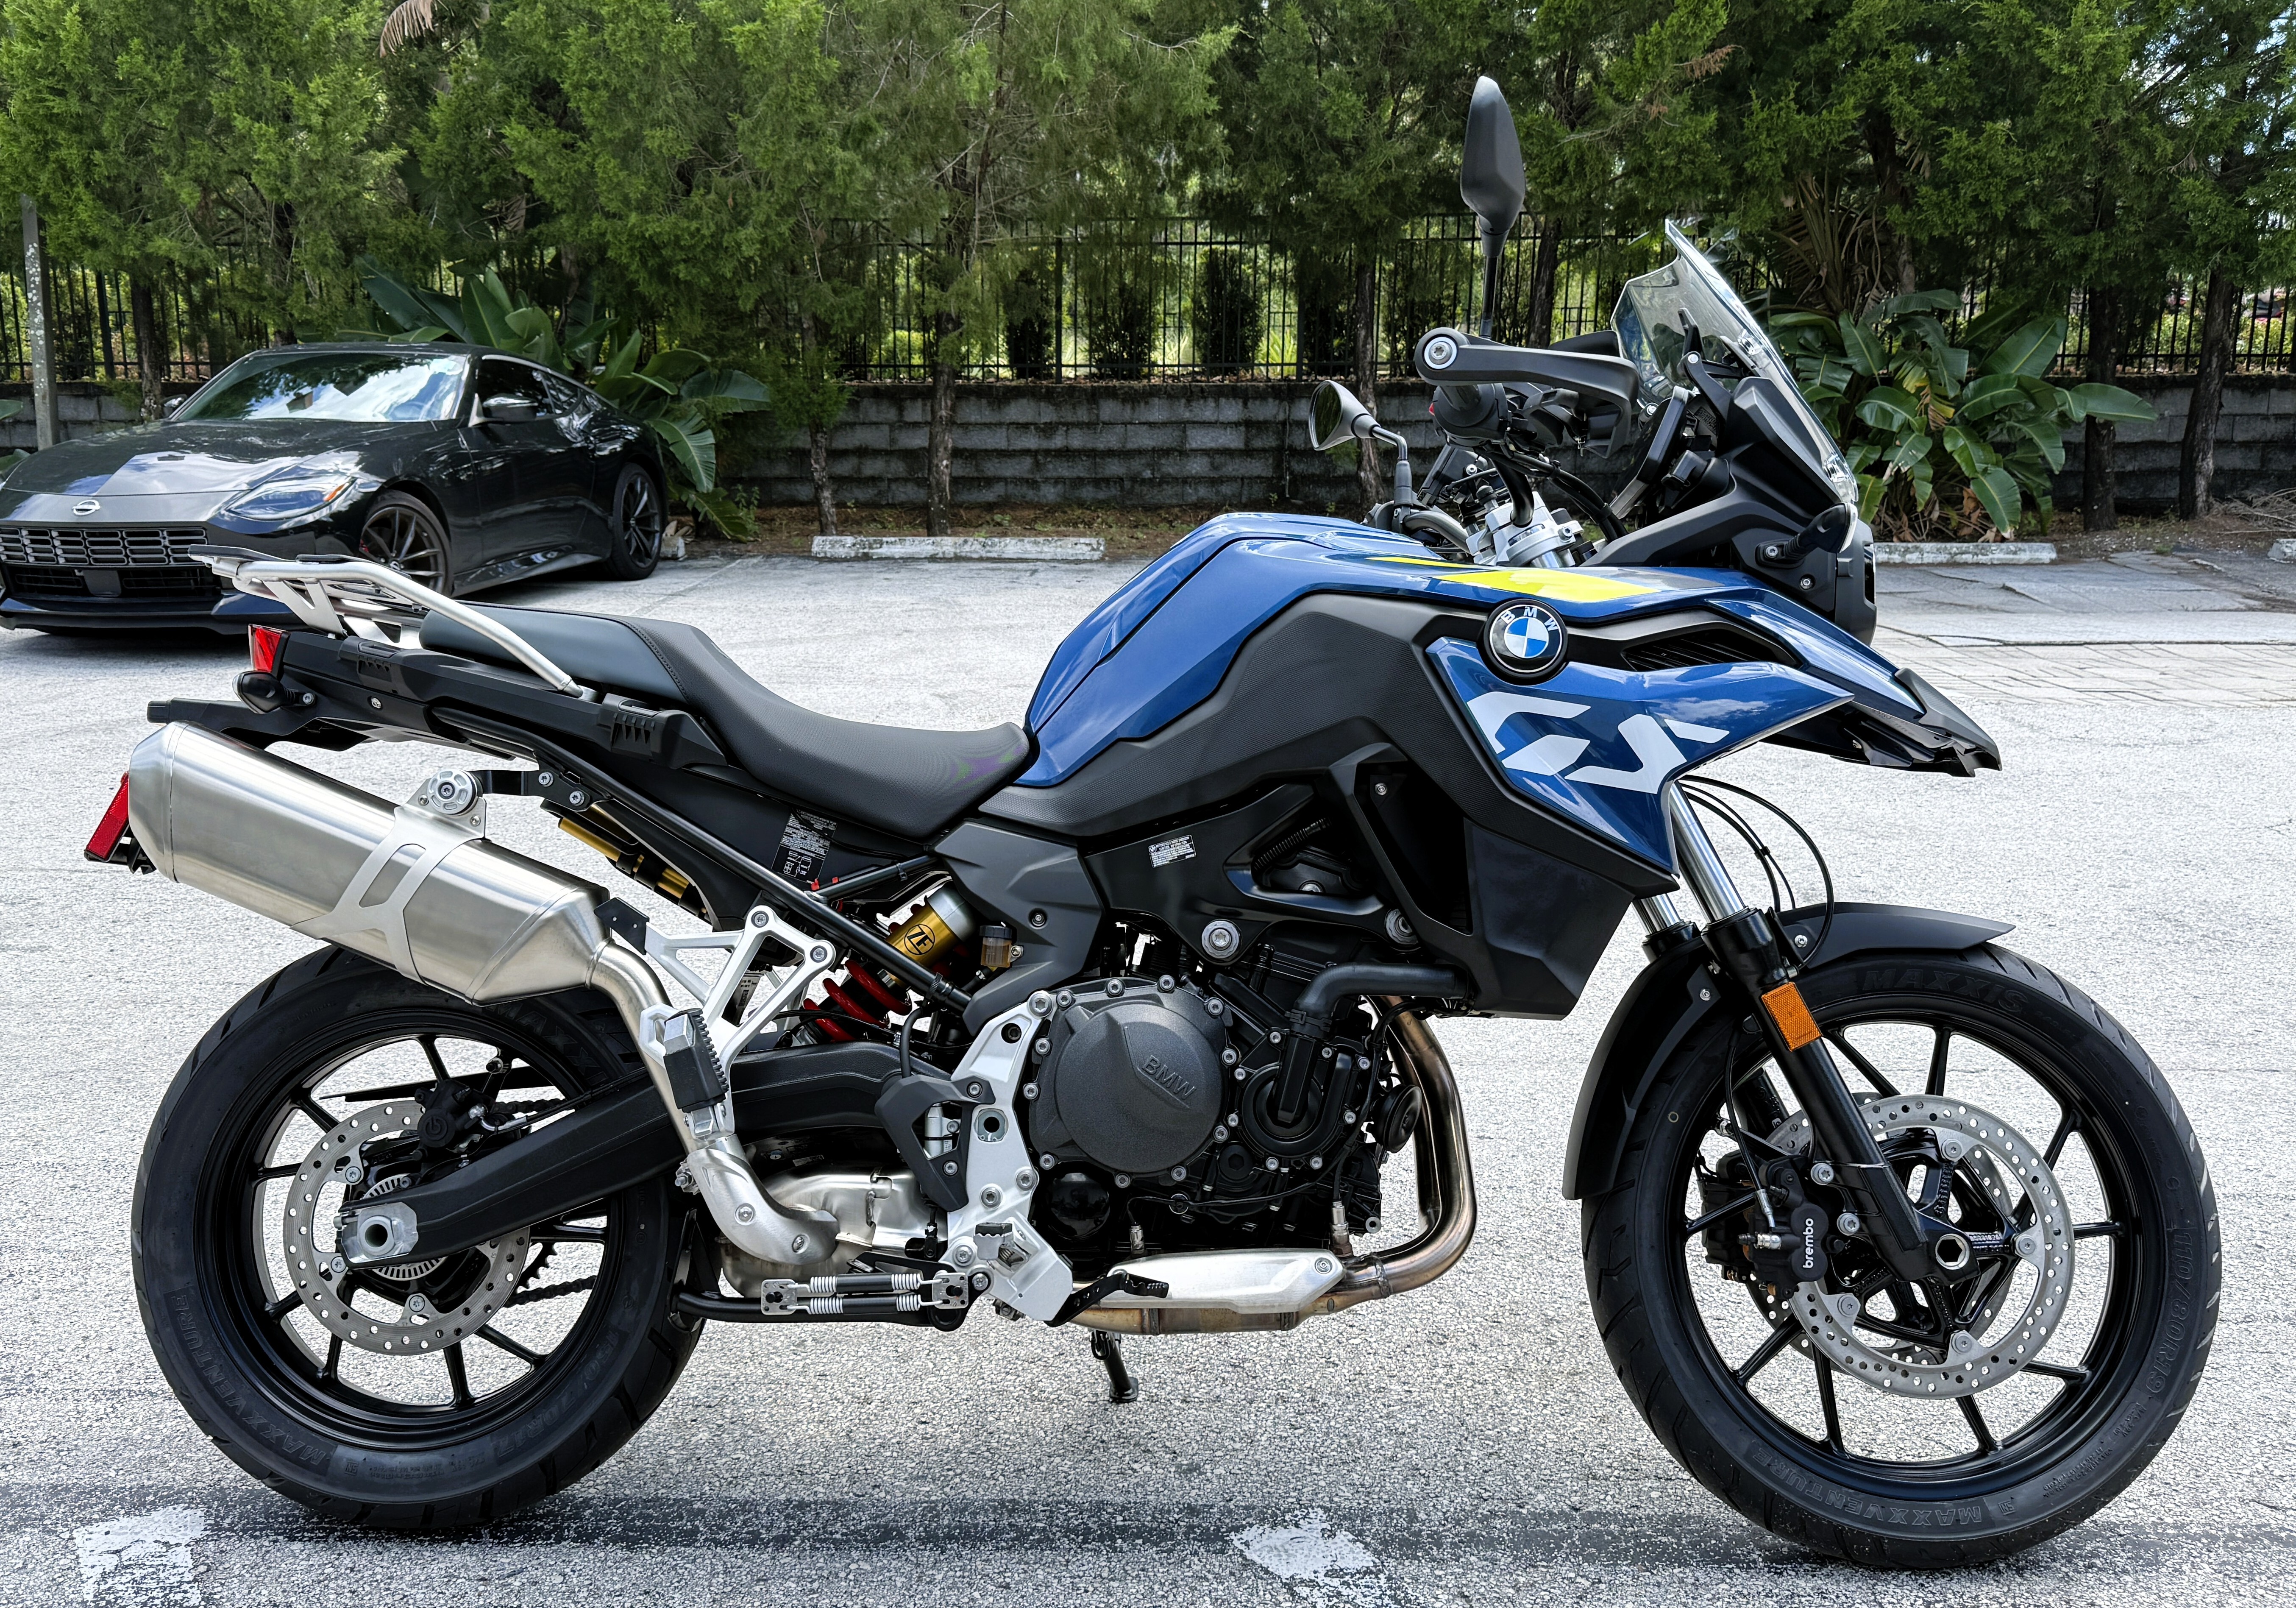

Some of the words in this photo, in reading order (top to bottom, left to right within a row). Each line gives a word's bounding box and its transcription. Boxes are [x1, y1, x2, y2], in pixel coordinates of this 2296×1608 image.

[1501, 606, 1558, 631] BMW
[905, 925, 934, 955] ZF
[1862, 969, 2029, 1014] MAXXIS
[487, 1003, 609, 1085] MAXXI
[1143, 1055, 1196, 1100] BMW
[1803, 1218, 1813, 1268] brembo
[2146, 1231, 2193, 1393] 110/80R19
[172, 1295, 327, 1466] MAXXVENTURE
[1754, 1447, 1982, 1526] MAXXVENTURE
[1999, 1501, 2016, 1516] SNI
